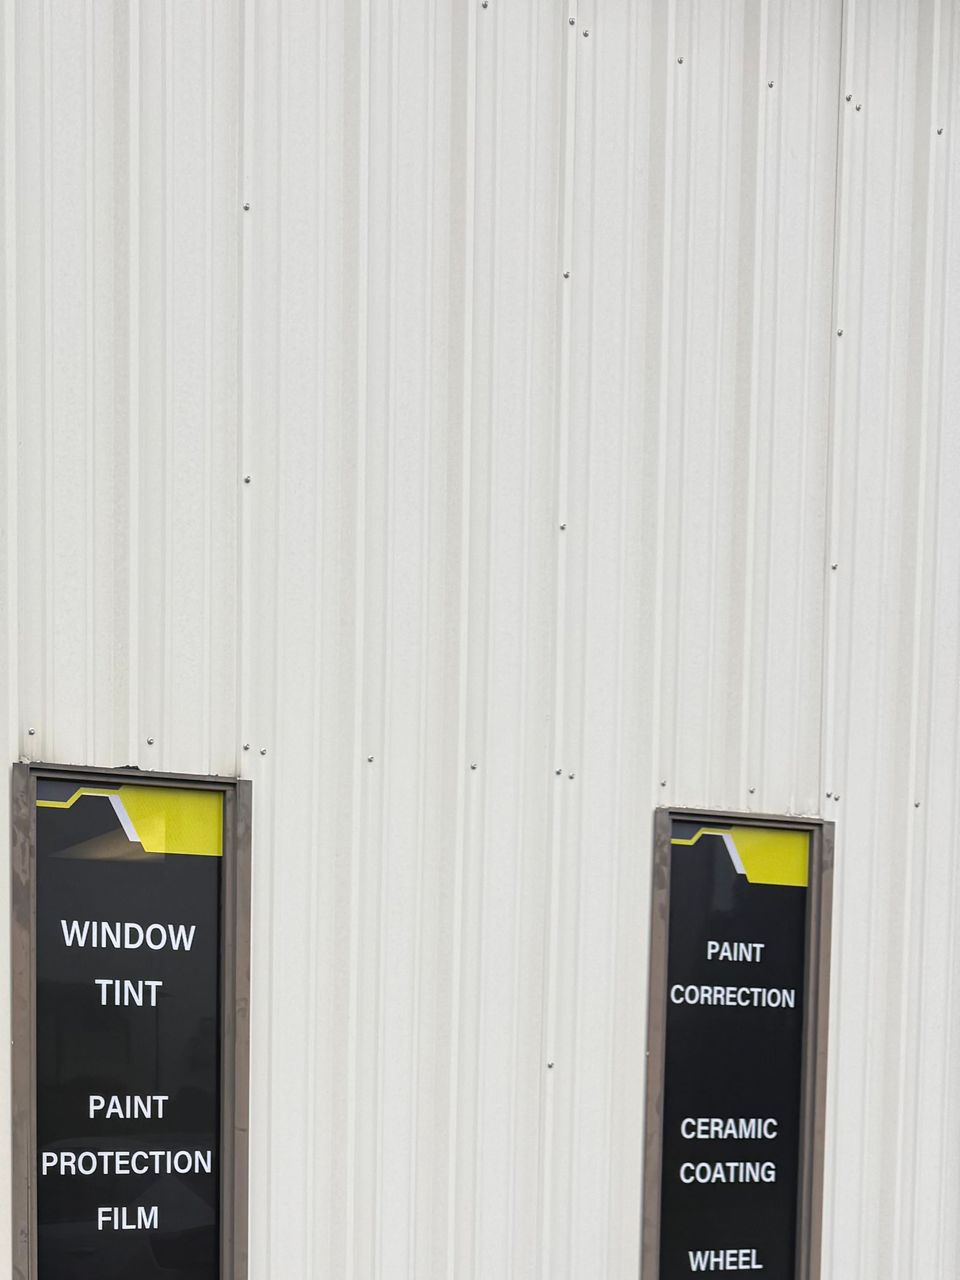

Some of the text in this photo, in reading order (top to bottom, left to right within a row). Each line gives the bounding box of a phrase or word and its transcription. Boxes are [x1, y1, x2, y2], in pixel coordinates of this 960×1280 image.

[60, 919, 196, 951] WINDOW
[707, 940, 765, 963] PAINT
[94, 979, 163, 1007] TINT
[670, 984, 795, 1008] CORRECTION
[89, 1095, 169, 1119] PAINT
[680, 1117, 778, 1139] CERAMIC
[42, 1150, 212, 1176] PROTECTION
[679, 1161, 776, 1184] COATING
[97, 1206, 159, 1231] FILM
[688, 1248, 763, 1272] WHEEL
